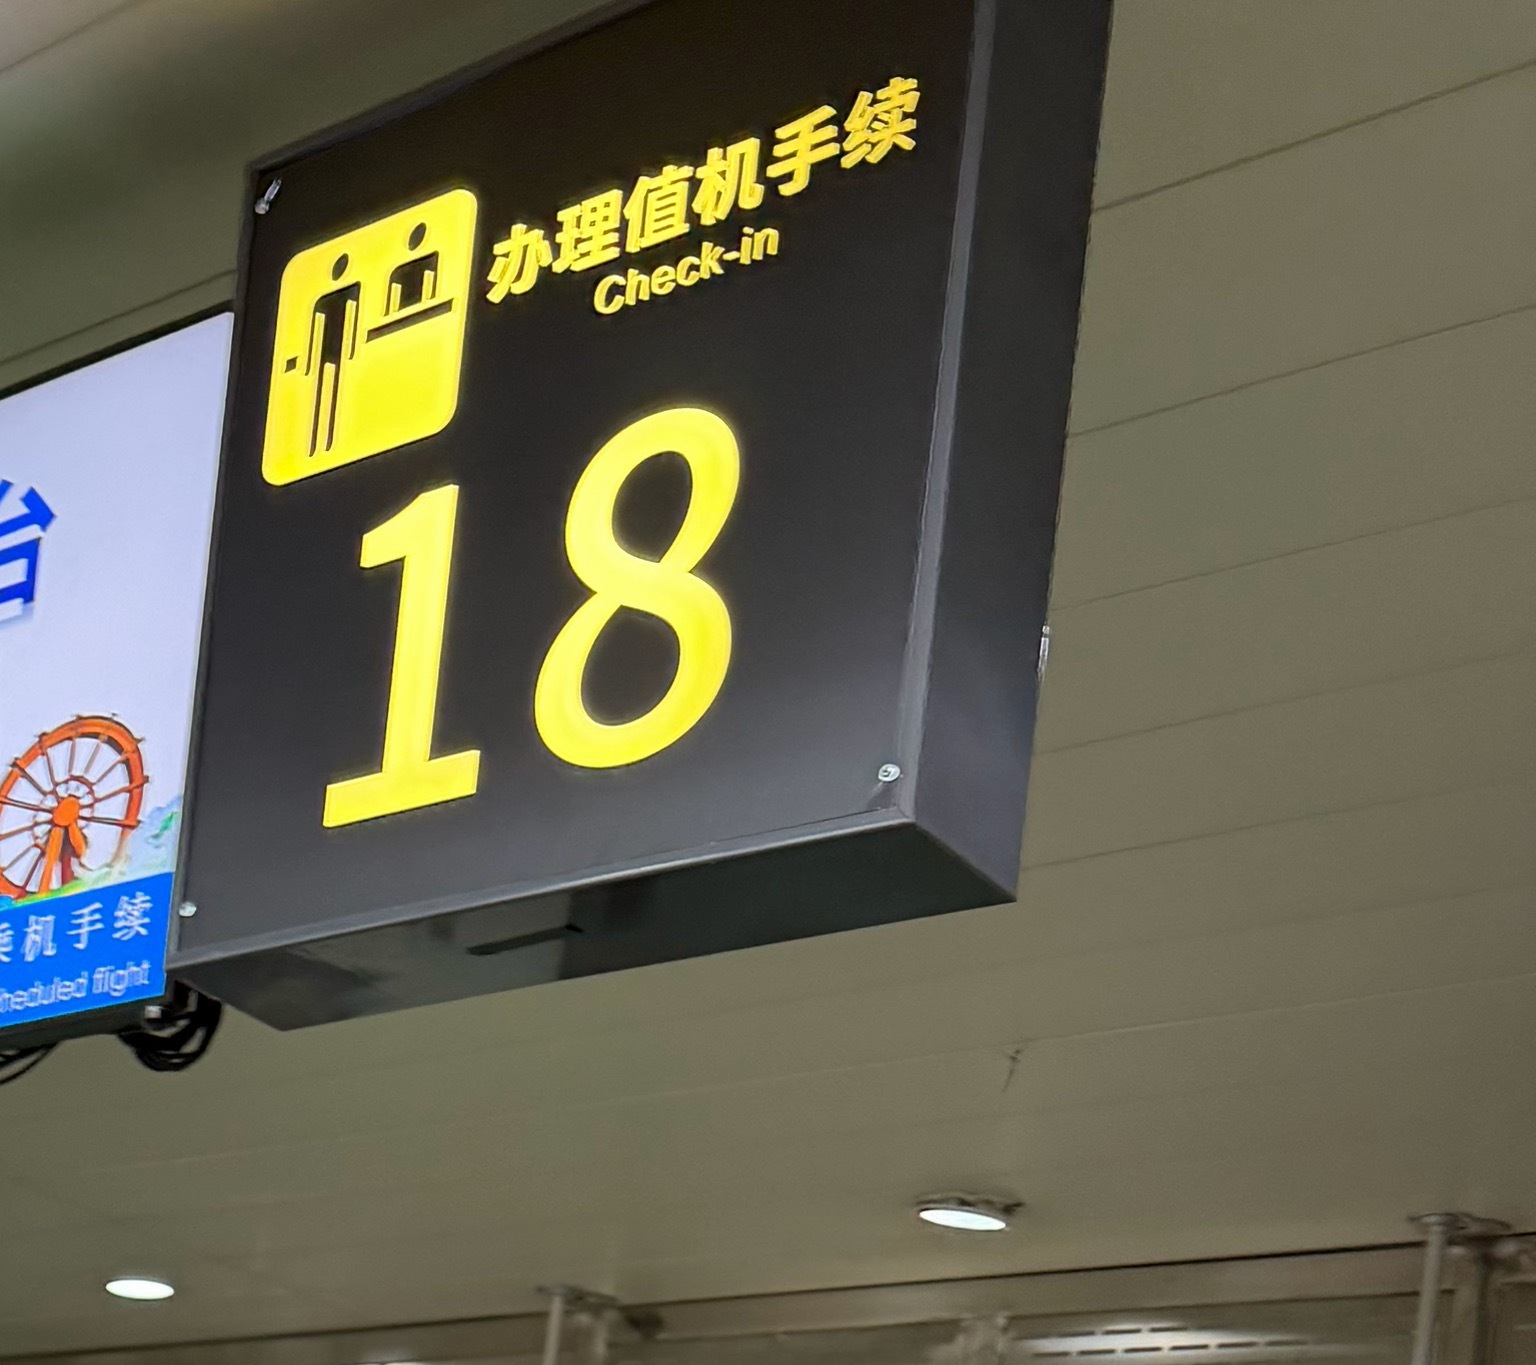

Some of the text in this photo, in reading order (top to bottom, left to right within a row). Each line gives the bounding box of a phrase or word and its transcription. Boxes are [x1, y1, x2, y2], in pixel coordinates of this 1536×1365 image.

[486, 76, 920, 305] 办理值机手续
[594, 221, 779, 316] Check-in
[323, 406, 741, 828] 18
[92, 960, 152, 996] flight
